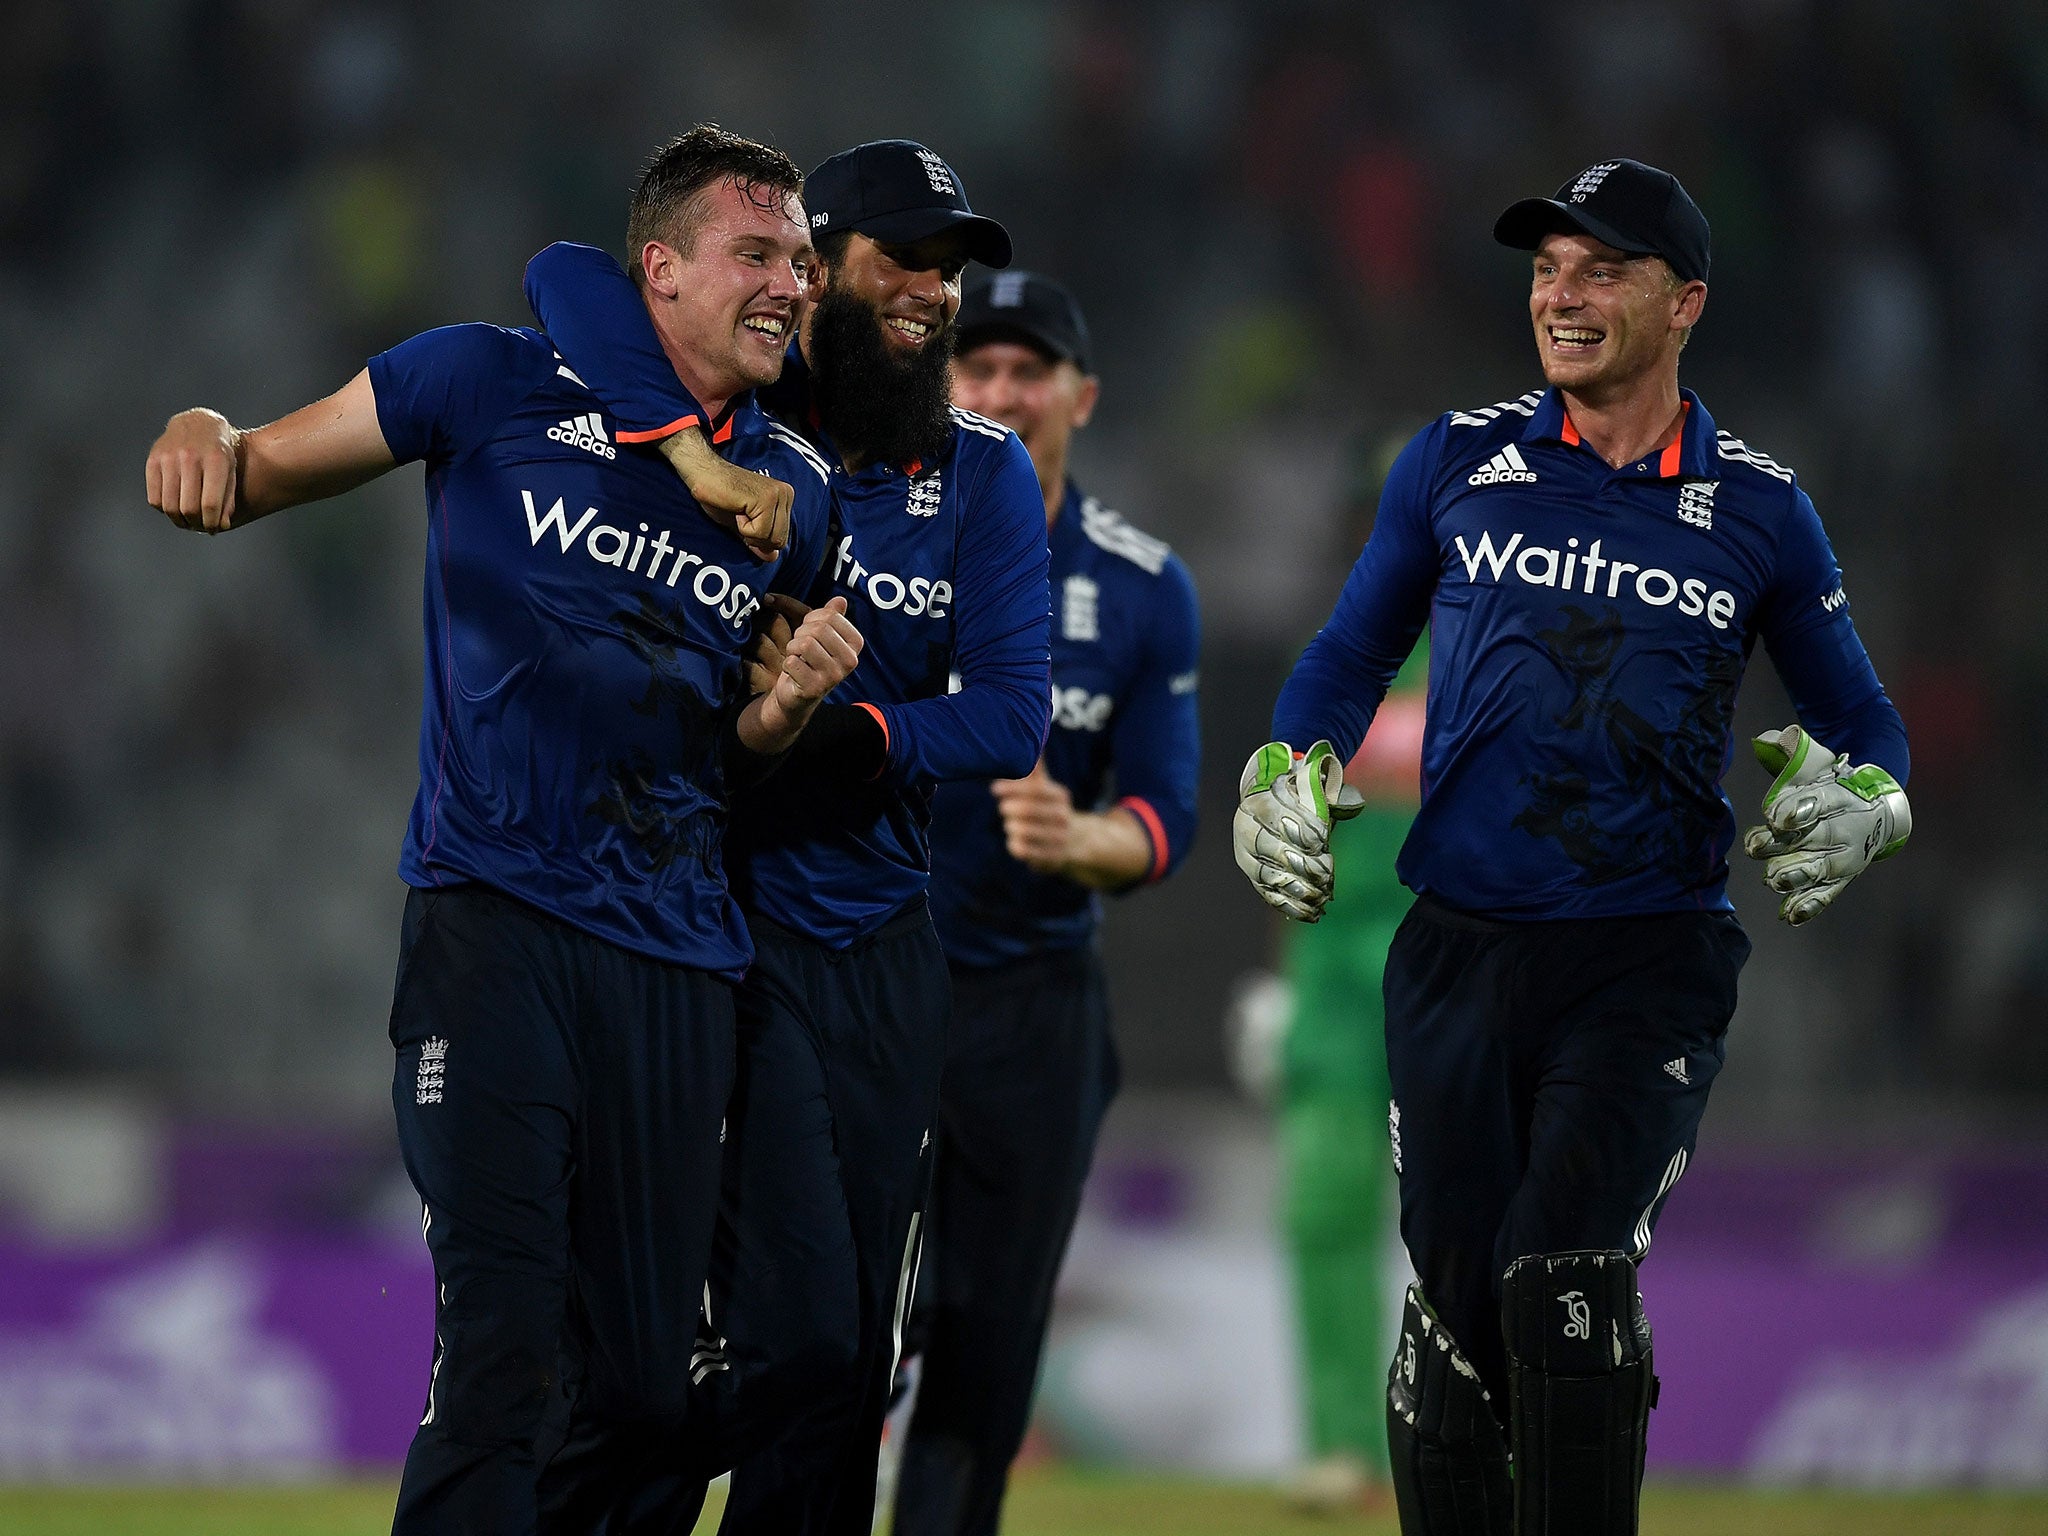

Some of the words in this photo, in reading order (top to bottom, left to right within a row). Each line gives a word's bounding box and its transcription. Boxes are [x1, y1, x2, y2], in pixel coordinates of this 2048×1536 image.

[1569, 193, 1586, 203] 50
[811, 212, 829, 228] 190
[546, 427, 617, 460] adidas
[1468, 468, 1537, 486] adidas
[818, 523, 953, 619] itrose
[1454, 531, 1736, 629] Waitrose
